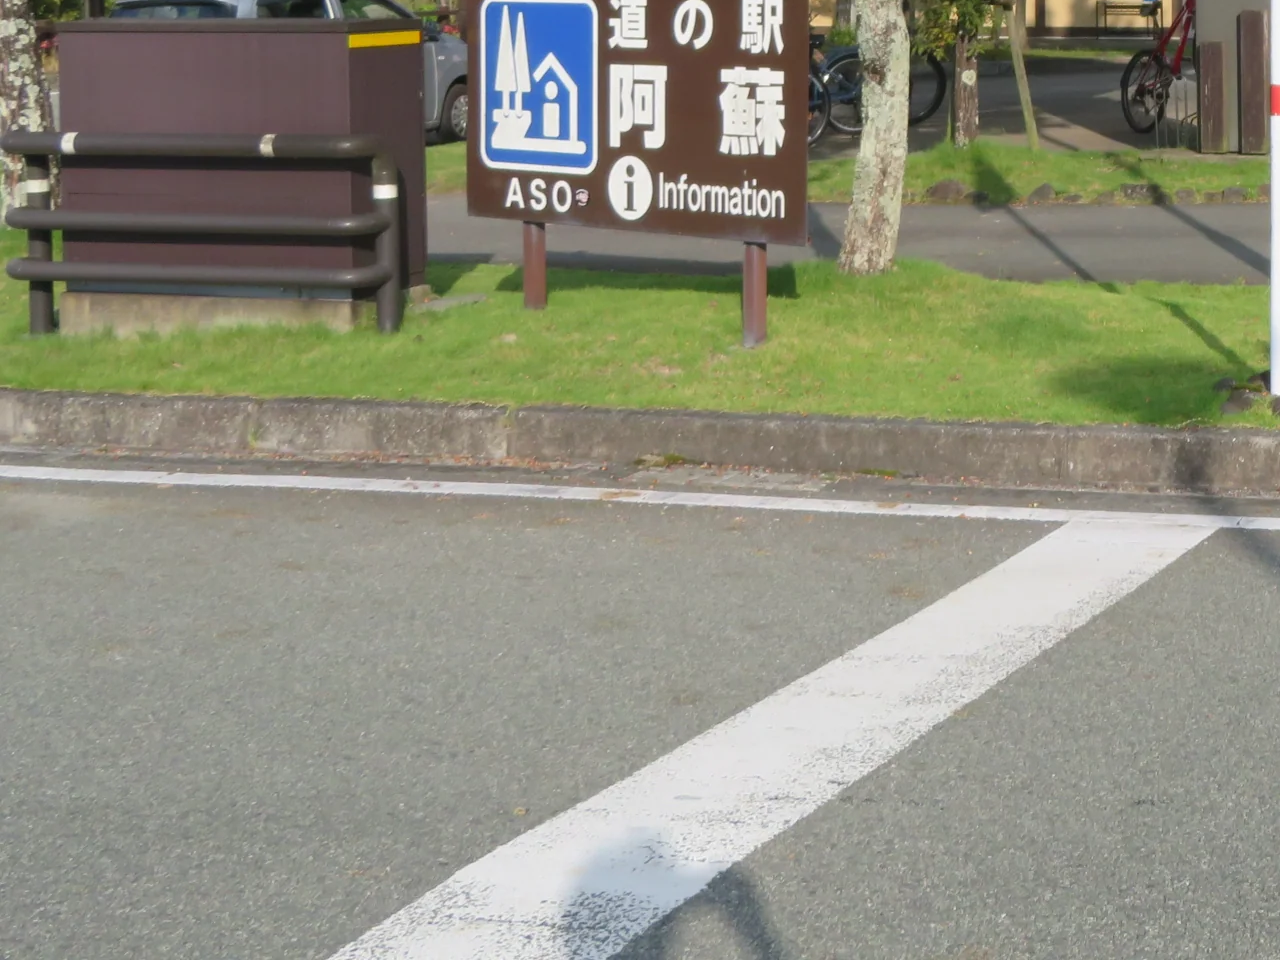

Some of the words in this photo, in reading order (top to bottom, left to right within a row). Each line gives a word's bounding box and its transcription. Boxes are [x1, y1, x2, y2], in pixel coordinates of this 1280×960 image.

[608, 63, 786, 157] 阿蘇
[505, 177, 572, 213] ASO
[658, 171, 786, 220] Information
